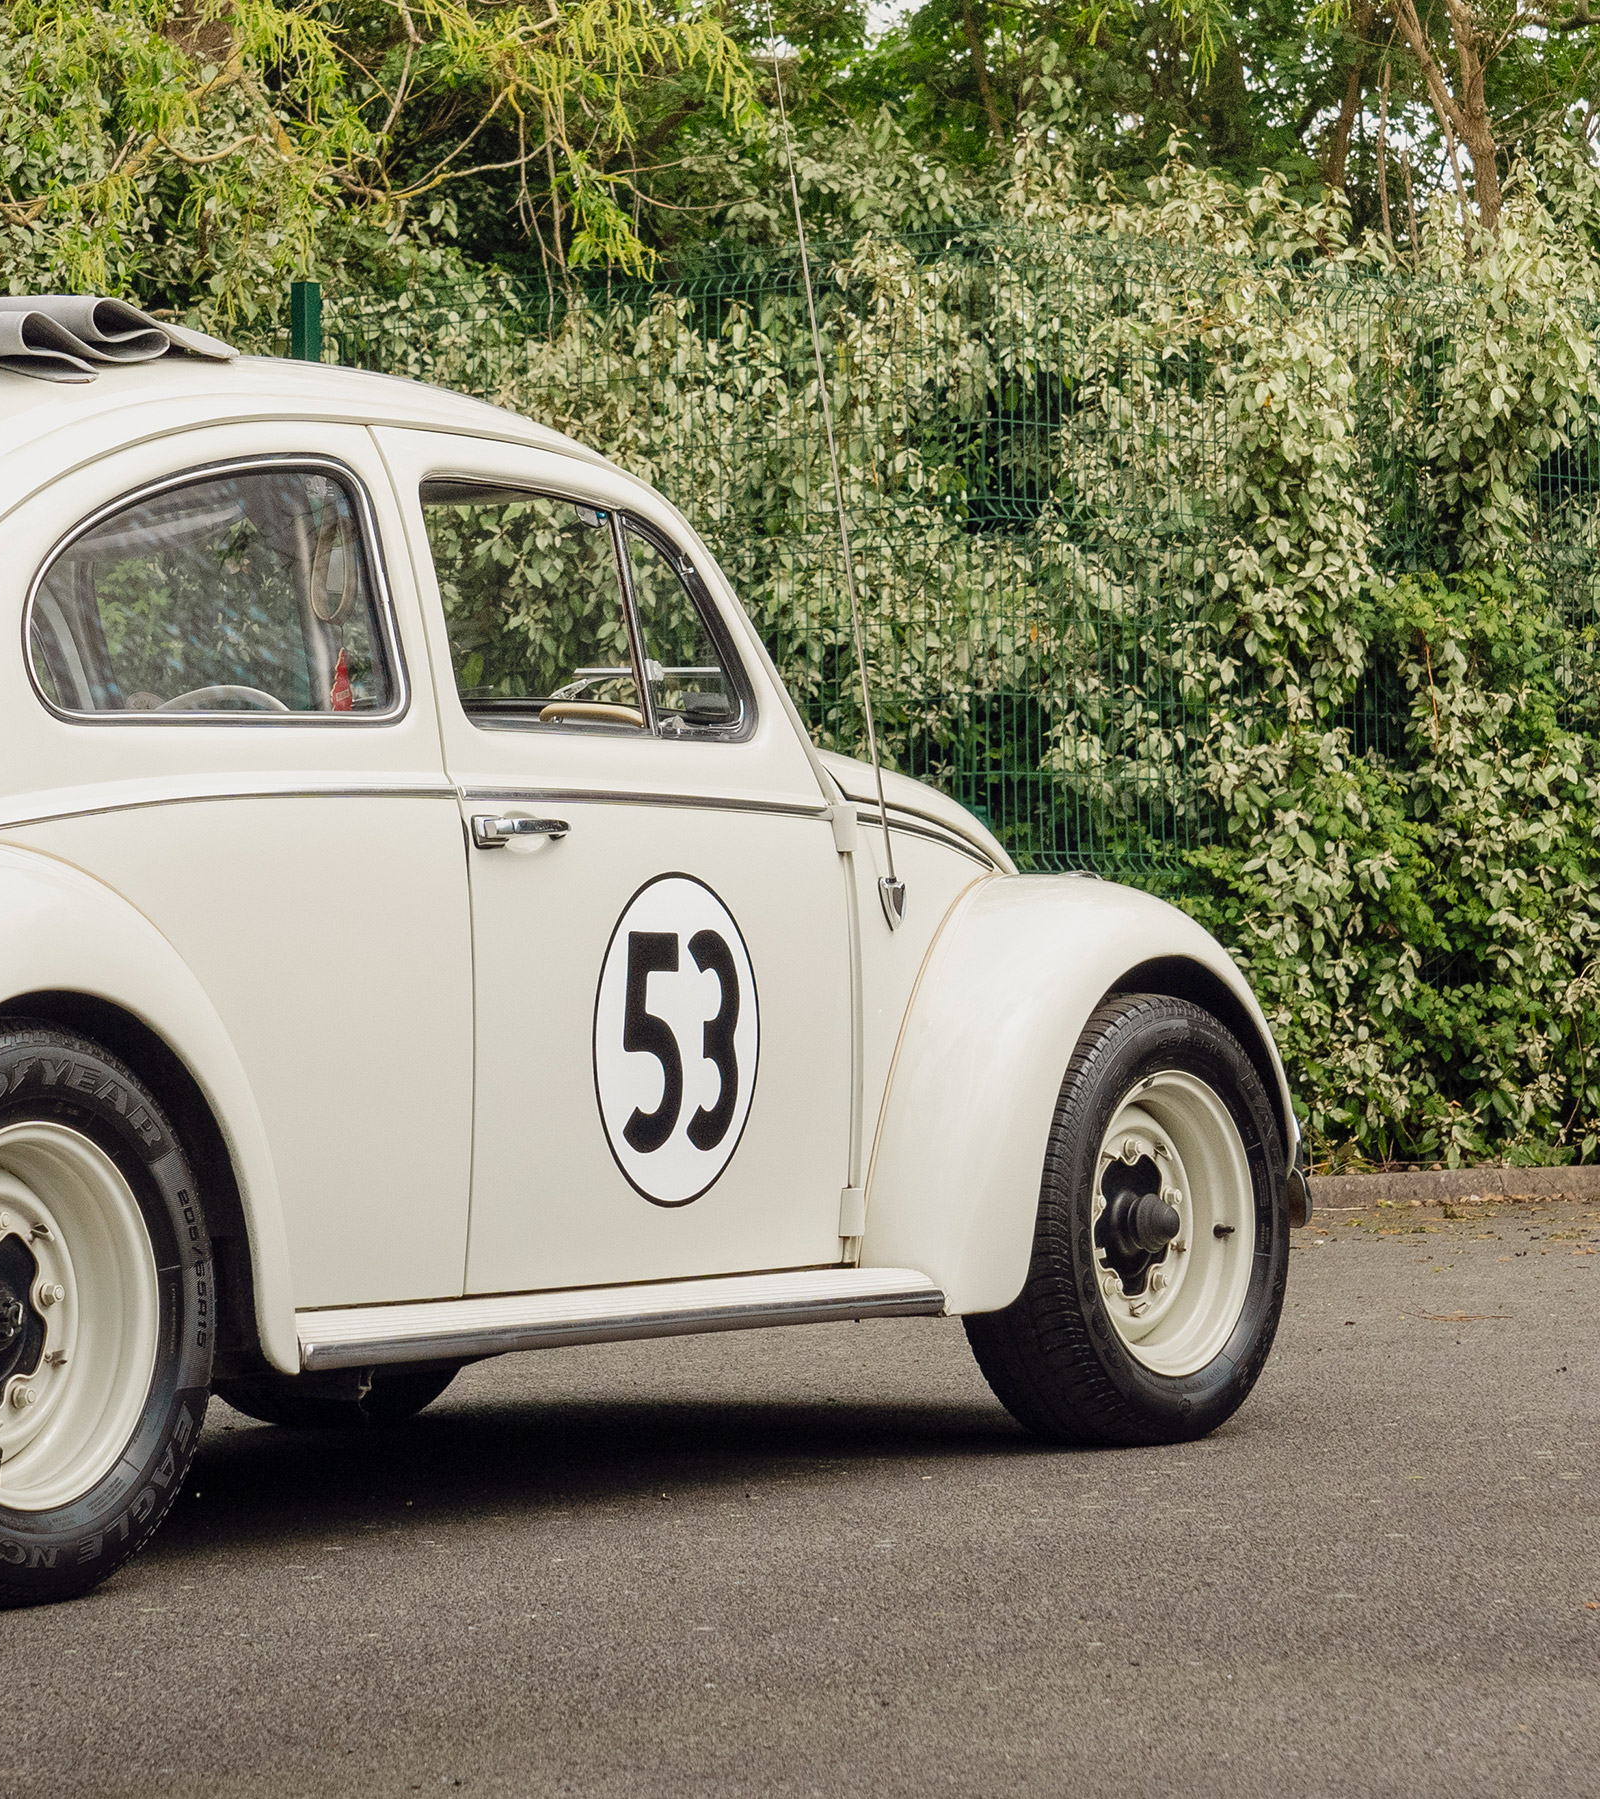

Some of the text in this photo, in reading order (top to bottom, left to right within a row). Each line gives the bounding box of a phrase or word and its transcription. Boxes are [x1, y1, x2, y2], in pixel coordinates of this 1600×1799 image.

[622, 929, 740, 1154] 53
[176, 1188, 208, 1349] 205/65R15
[76, 1400, 195, 1566] EAGLE
